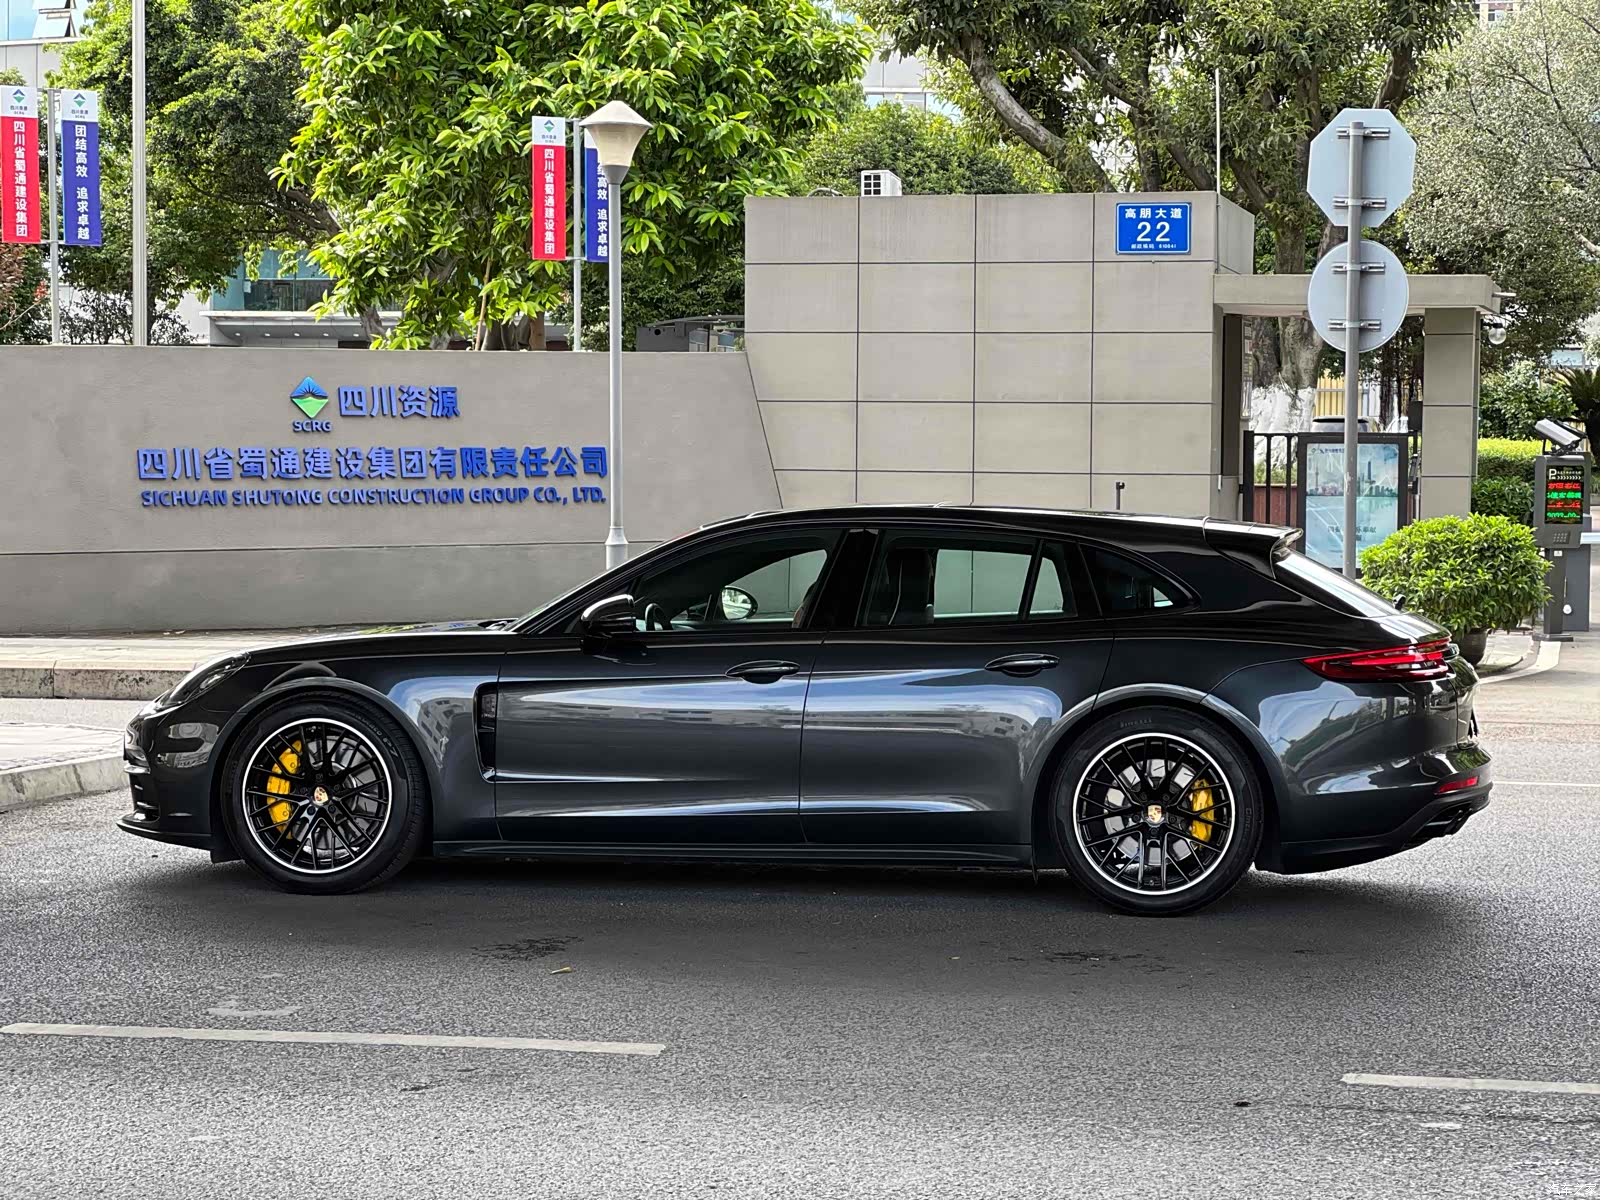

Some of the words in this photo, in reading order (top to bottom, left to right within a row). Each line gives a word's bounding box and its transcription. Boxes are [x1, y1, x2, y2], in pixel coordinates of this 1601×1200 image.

[75, 125, 88, 178] 团结高效
[13, 121, 28, 237] 四川省蜀通建设集团
[76, 187, 90, 240] 追求卓越
[1125, 208, 1182, 219] 高朋大道
[1136, 221, 1170, 242] 22
[338, 385, 460, 418] 四川资源
[292, 420, 333, 433] SCRG
[137, 447, 608, 480] 四川省蜀通建设集团有限责任公司
[141, 489, 228, 507] SICHUAN
[231, 488, 323, 507] SHUTONG
[327, 487, 464, 505] CONSTRUCTION
[469, 487, 530, 504] GROUP
[533, 487, 568, 505] CO.,
[572, 486, 607, 503] LTD.
